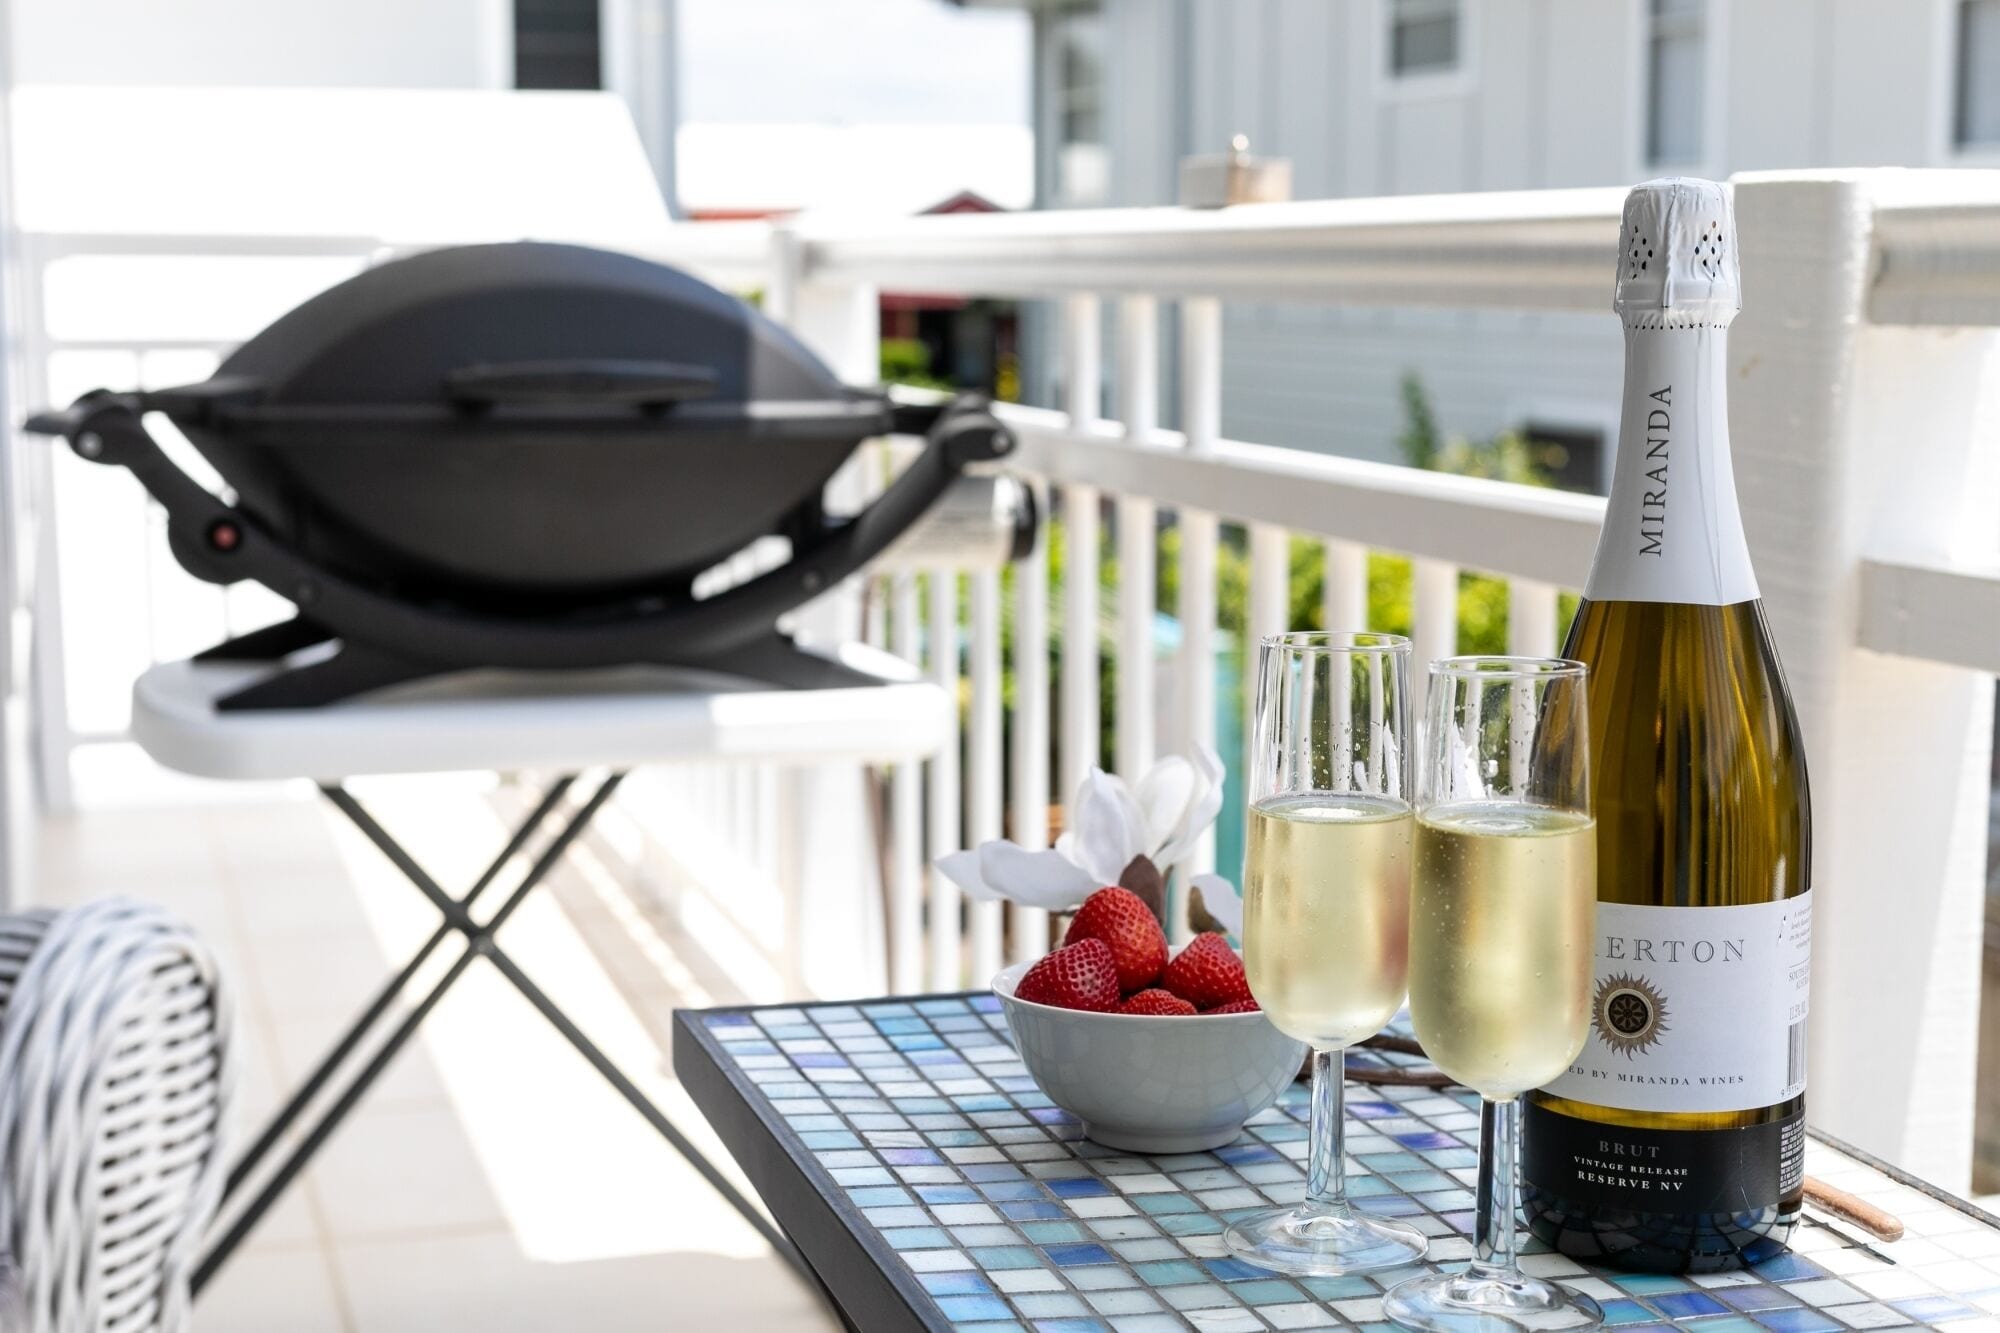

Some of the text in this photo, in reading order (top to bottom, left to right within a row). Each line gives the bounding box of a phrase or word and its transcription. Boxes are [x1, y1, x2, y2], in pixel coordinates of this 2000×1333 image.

[1639, 384, 1672, 557] MIRANDA
[1596, 936, 1745, 963] ERTON
[1568, 1065, 1745, 1086] ED BY MIRANDA WINES
[1599, 1140, 1660, 1158] BRUT
[1574, 1155, 1689, 1176] VINTAGE RELEASE
[1578, 1170, 1683, 1191] RESERVE NV
